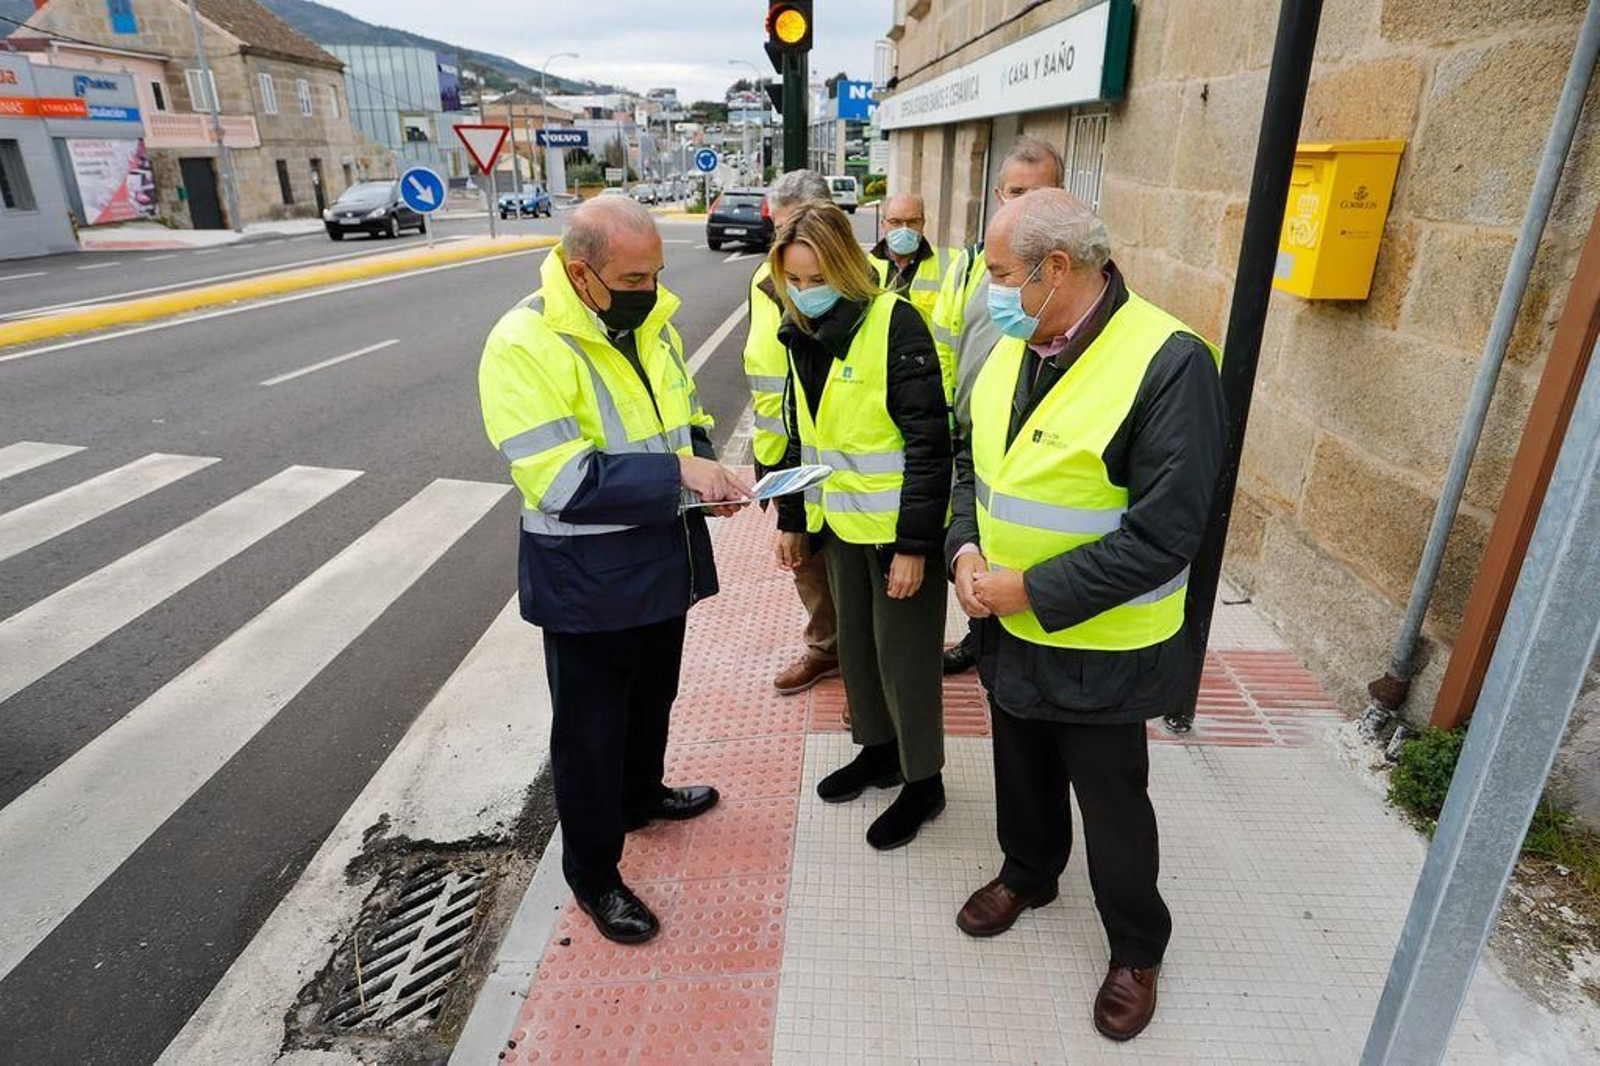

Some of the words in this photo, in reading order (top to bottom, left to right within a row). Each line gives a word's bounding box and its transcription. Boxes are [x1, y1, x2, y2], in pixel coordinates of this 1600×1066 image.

[1009, 61, 1029, 86] CASA
[1034, 56, 1041, 79] Y
[1043, 40, 1076, 77] BAÑO
[540, 133, 582, 143] VOLVO
